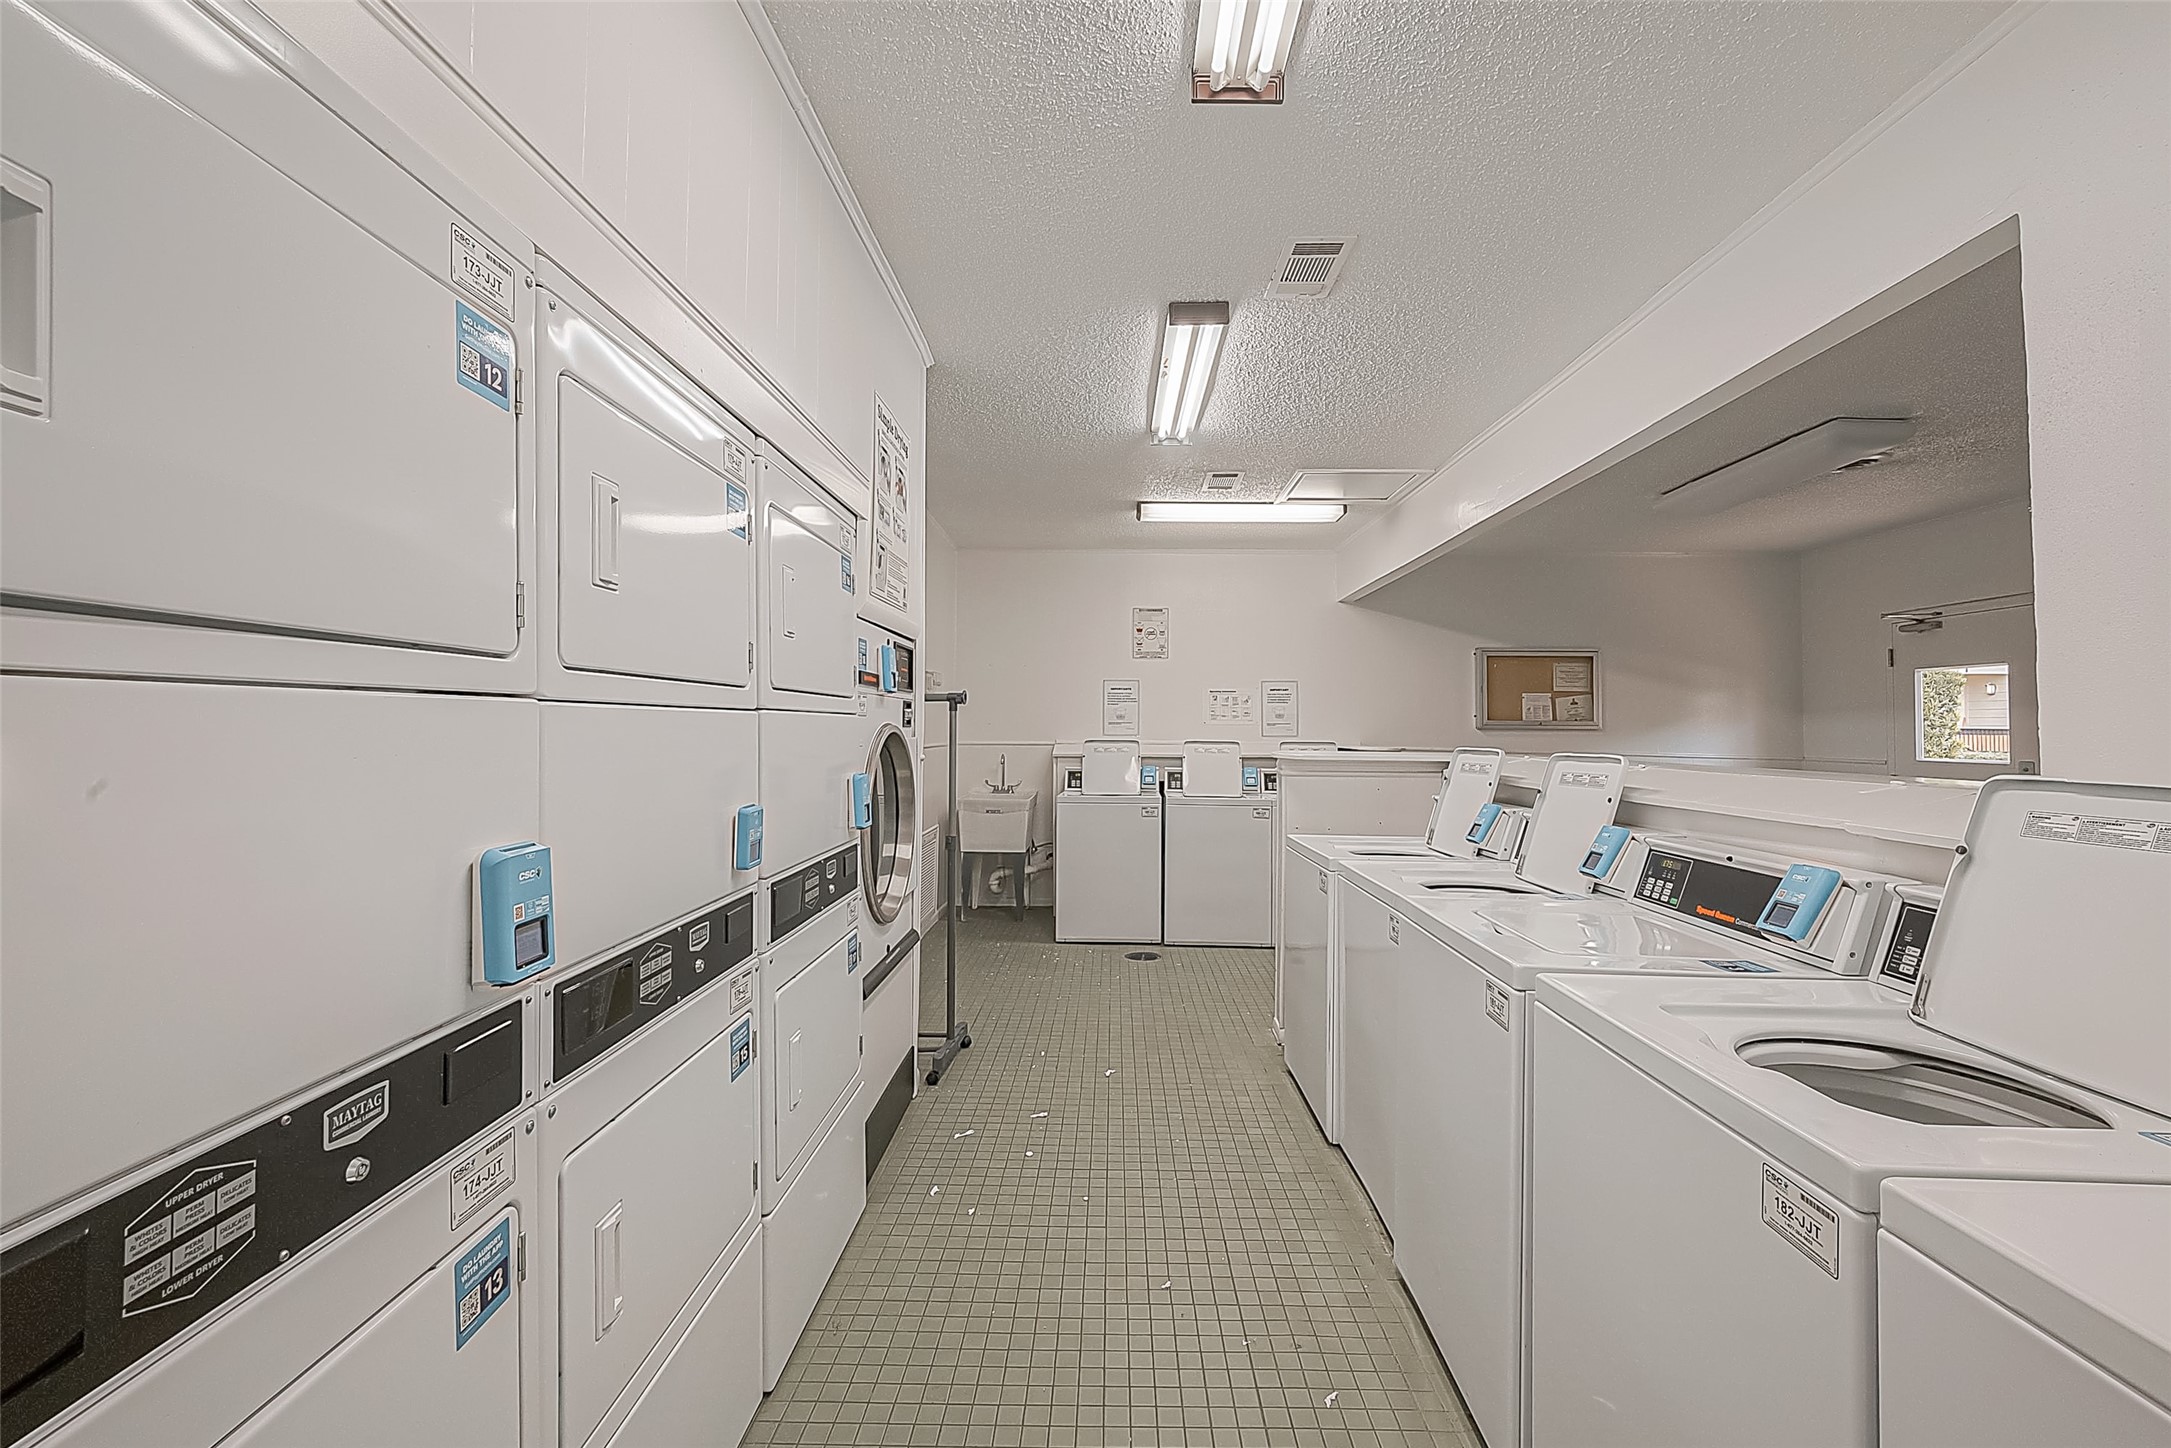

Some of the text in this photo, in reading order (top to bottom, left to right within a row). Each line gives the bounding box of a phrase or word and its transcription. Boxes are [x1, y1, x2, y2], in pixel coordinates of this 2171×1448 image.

[454, 229, 470, 245] CSC
[463, 256, 502, 292] 173-JJT
[463, 314, 473, 326] DO
[485, 363, 502, 392] 12
[878, 403, 893, 435] Simple
[894, 425, 908, 459] Drying
[519, 869, 536, 881] CSC
[1696, 905, 1715, 917] Speed
[1715, 910, 1735, 923] Queen
[740, 1045, 748, 1063] 15
[332, 1093, 382, 1129] MAYTAG
[453, 1162, 470, 1179] CSC
[463, 1158, 503, 1197] 174-JJT
[1765, 1169, 1783, 1185] CSC
[165, 1172, 224, 1208] UPPER DRYER
[220, 1178, 252, 1199] DELICATES
[223, 1187, 250, 1204] LOW HEAT
[184, 1207, 205, 1222] PRESS
[185, 1200, 204, 1214] PERM
[199, 1209, 214, 1221] HEAT
[219, 1212, 252, 1235] DELICATES
[1775, 1196, 1821, 1239] 182-JJT
[134, 1222, 163, 1242] WHITES
[138, 1228, 167, 1247] COLORS
[149, 1236, 165, 1250] HEAT
[183, 1243, 205, 1259] PRESS
[184, 1236, 204, 1252] PERM
[462, 1260, 472, 1273] DO
[474, 1233, 502, 1264] LAUNDRY
[133, 1261, 163, 1282] WHITES
[461, 1264, 478, 1283] WITH
[492, 1240, 504, 1257] APP
[137, 1267, 167, 1287] COLORS
[161, 1254, 224, 1298] LOWER DRYER
[484, 1267, 503, 1301] 13
